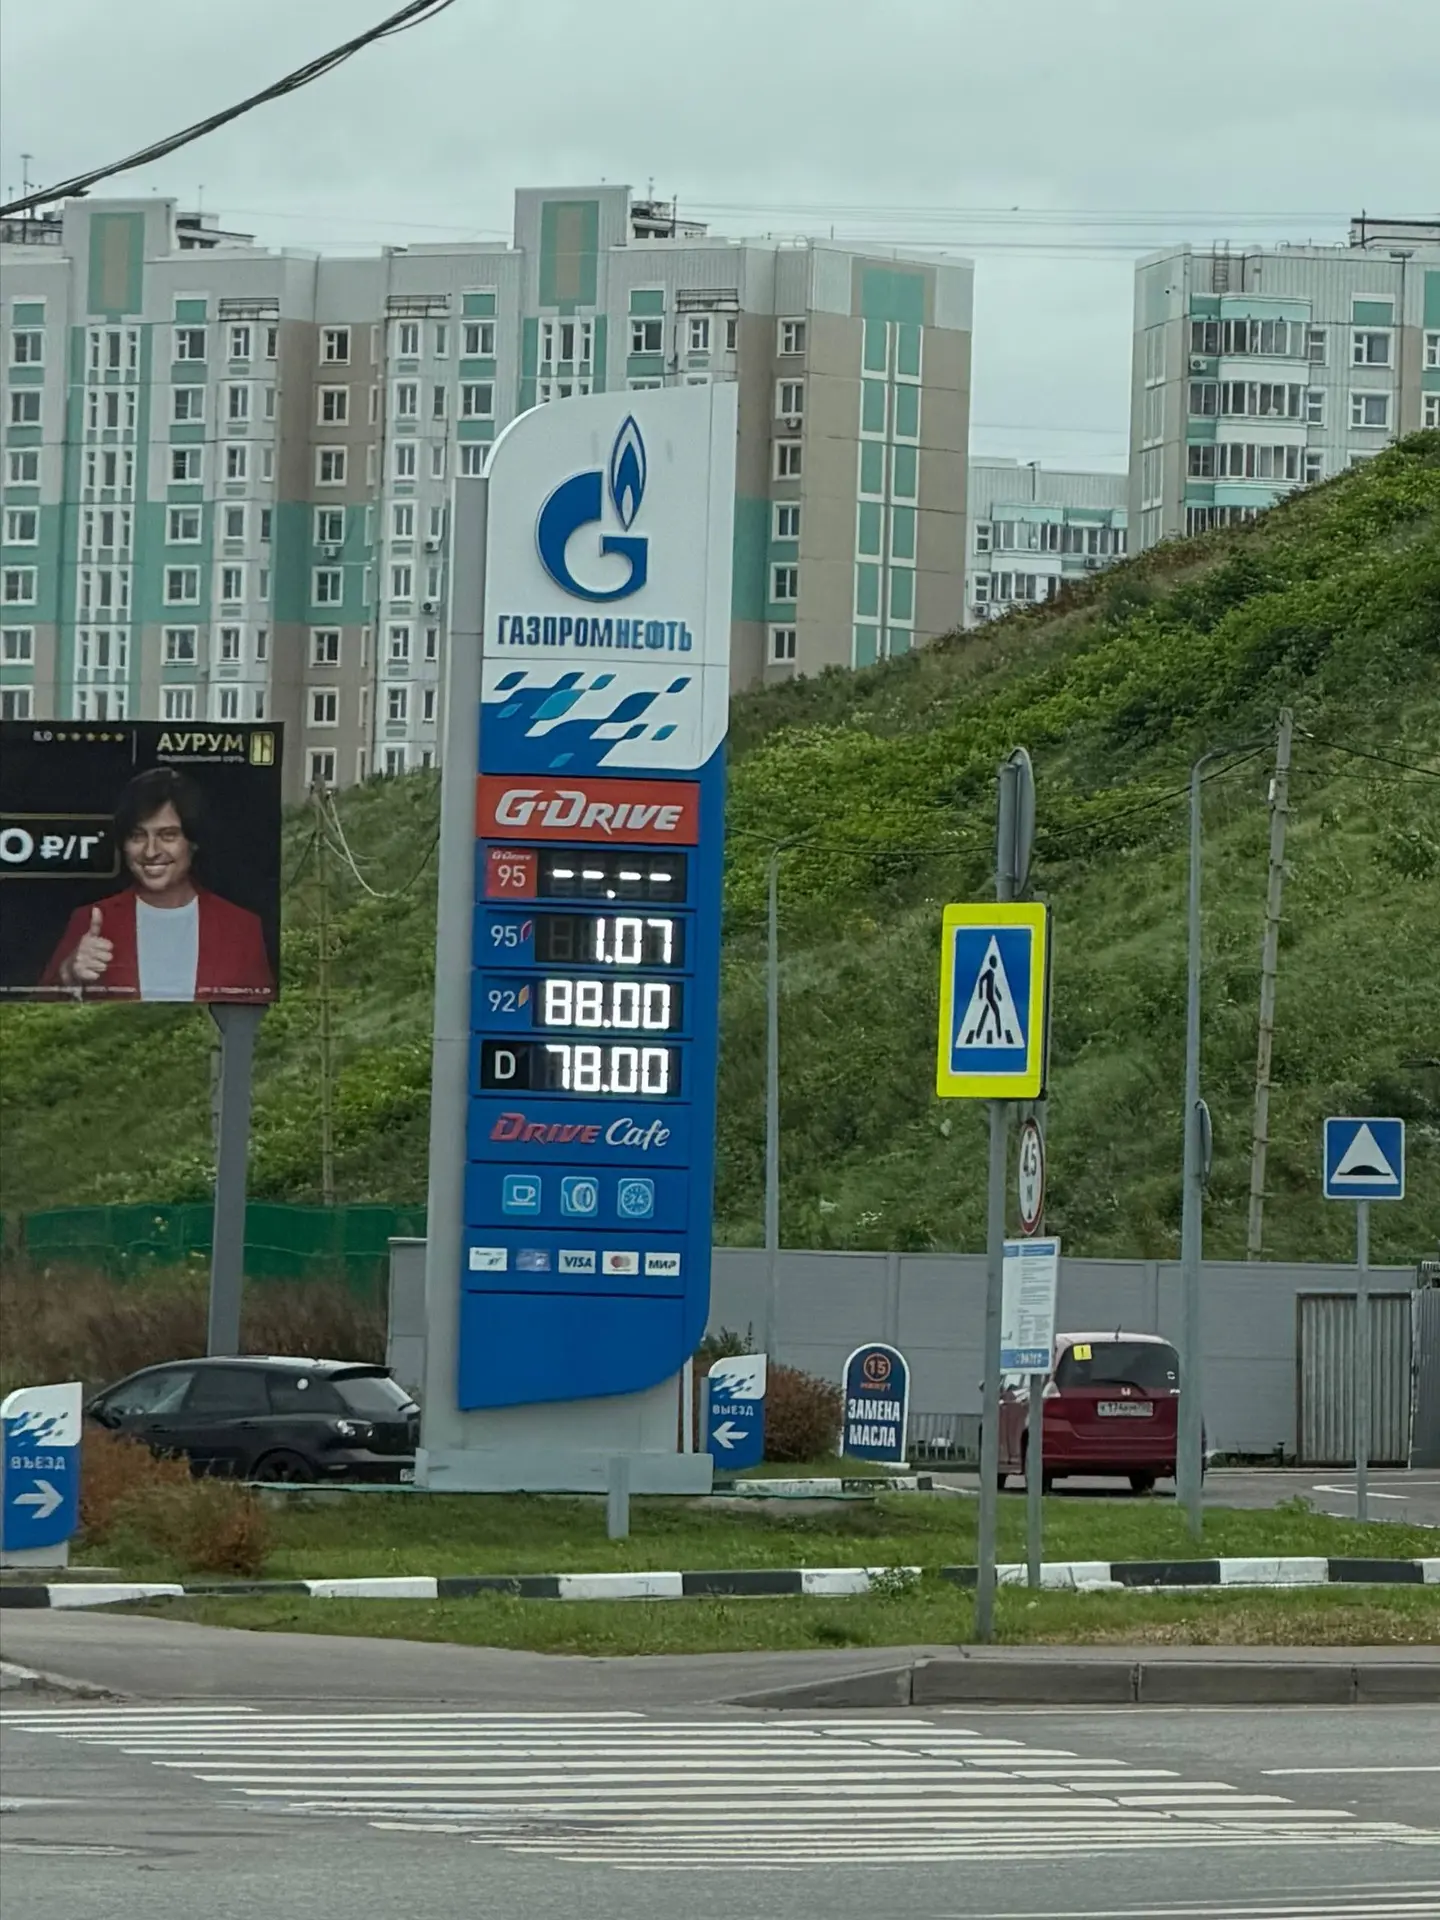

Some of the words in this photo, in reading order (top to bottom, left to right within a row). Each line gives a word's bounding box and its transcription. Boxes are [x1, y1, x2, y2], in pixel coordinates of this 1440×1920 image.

[497, 614, 693, 652] ГАЗПРОМНЕФТЬ
[156, 732, 245, 753] АУРУМ
[498, 864, 527, 887] 95
[490, 924, 518, 948] 95
[595, 917, 673, 965] 1.07
[488, 989, 516, 1013] 92
[544, 979, 672, 1030] 88.00
[493, 1050, 516, 1080] D
[545, 1043, 670, 1095] 78.00
[490, 1112, 603, 1145] DRIVE
[563, 1255, 593, 1269] VISA
[648, 1259, 677, 1270] МИР
[868, 1359, 887, 1376] 15
[712, 1404, 754, 1416] ВЫЕЗД
[847, 1398, 901, 1423] ЗАМЕНА
[848, 1423, 897, 1448] МАСЛА
[11, 1456, 66, 1470] ВЪЕЗД
